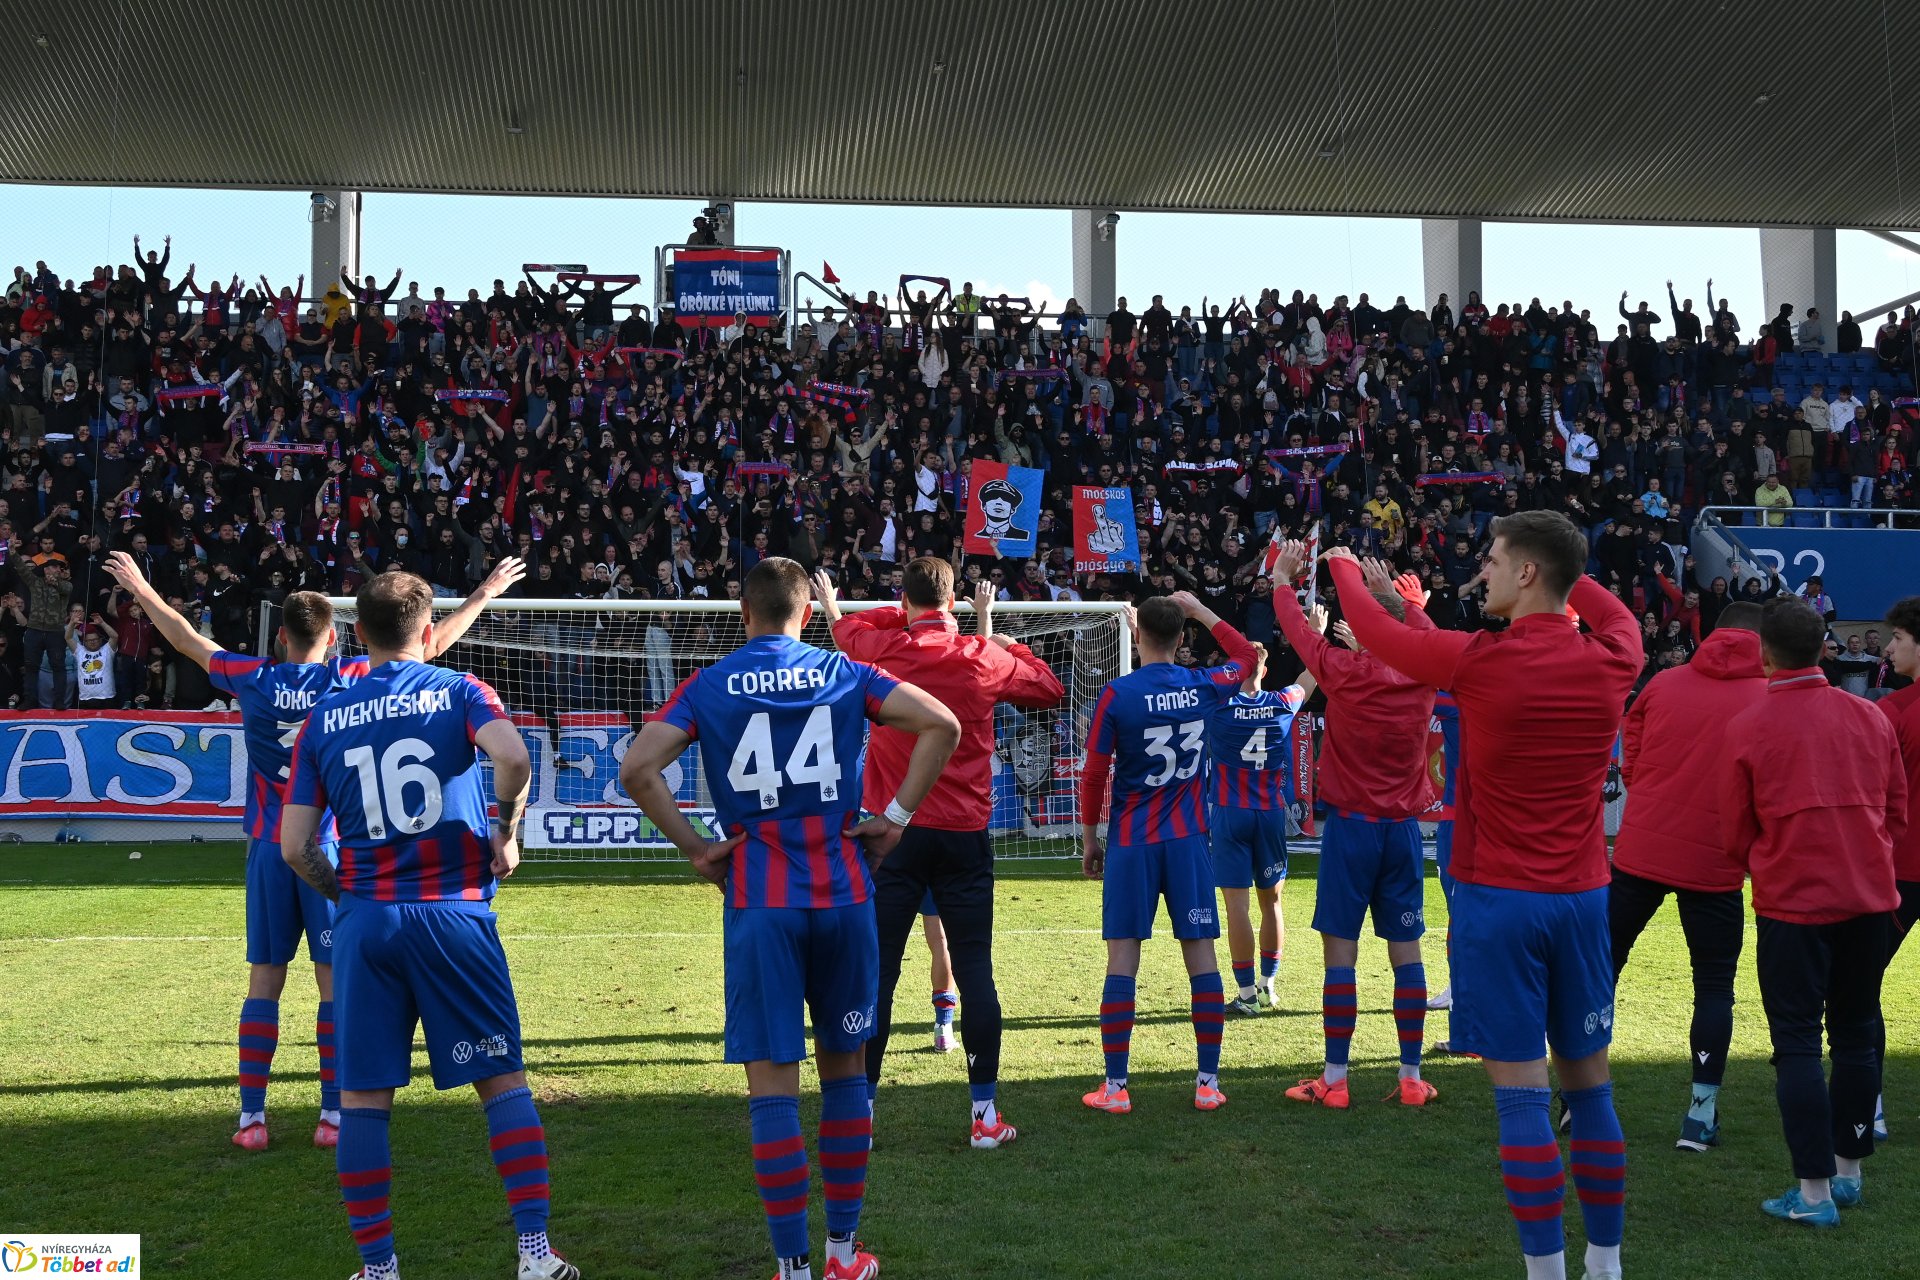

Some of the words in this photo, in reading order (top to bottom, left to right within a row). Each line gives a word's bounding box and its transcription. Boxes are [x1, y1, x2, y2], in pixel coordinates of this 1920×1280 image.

[727, 293, 775, 311] VELÜNK!
[727, 667, 825, 695] CORREA
[1144, 687, 1200, 712] TAMÁS
[727, 705, 842, 810] 44
[1143, 719, 1205, 787] 33
[1240, 727, 1268, 770] 4
[343, 737, 443, 840] 16
